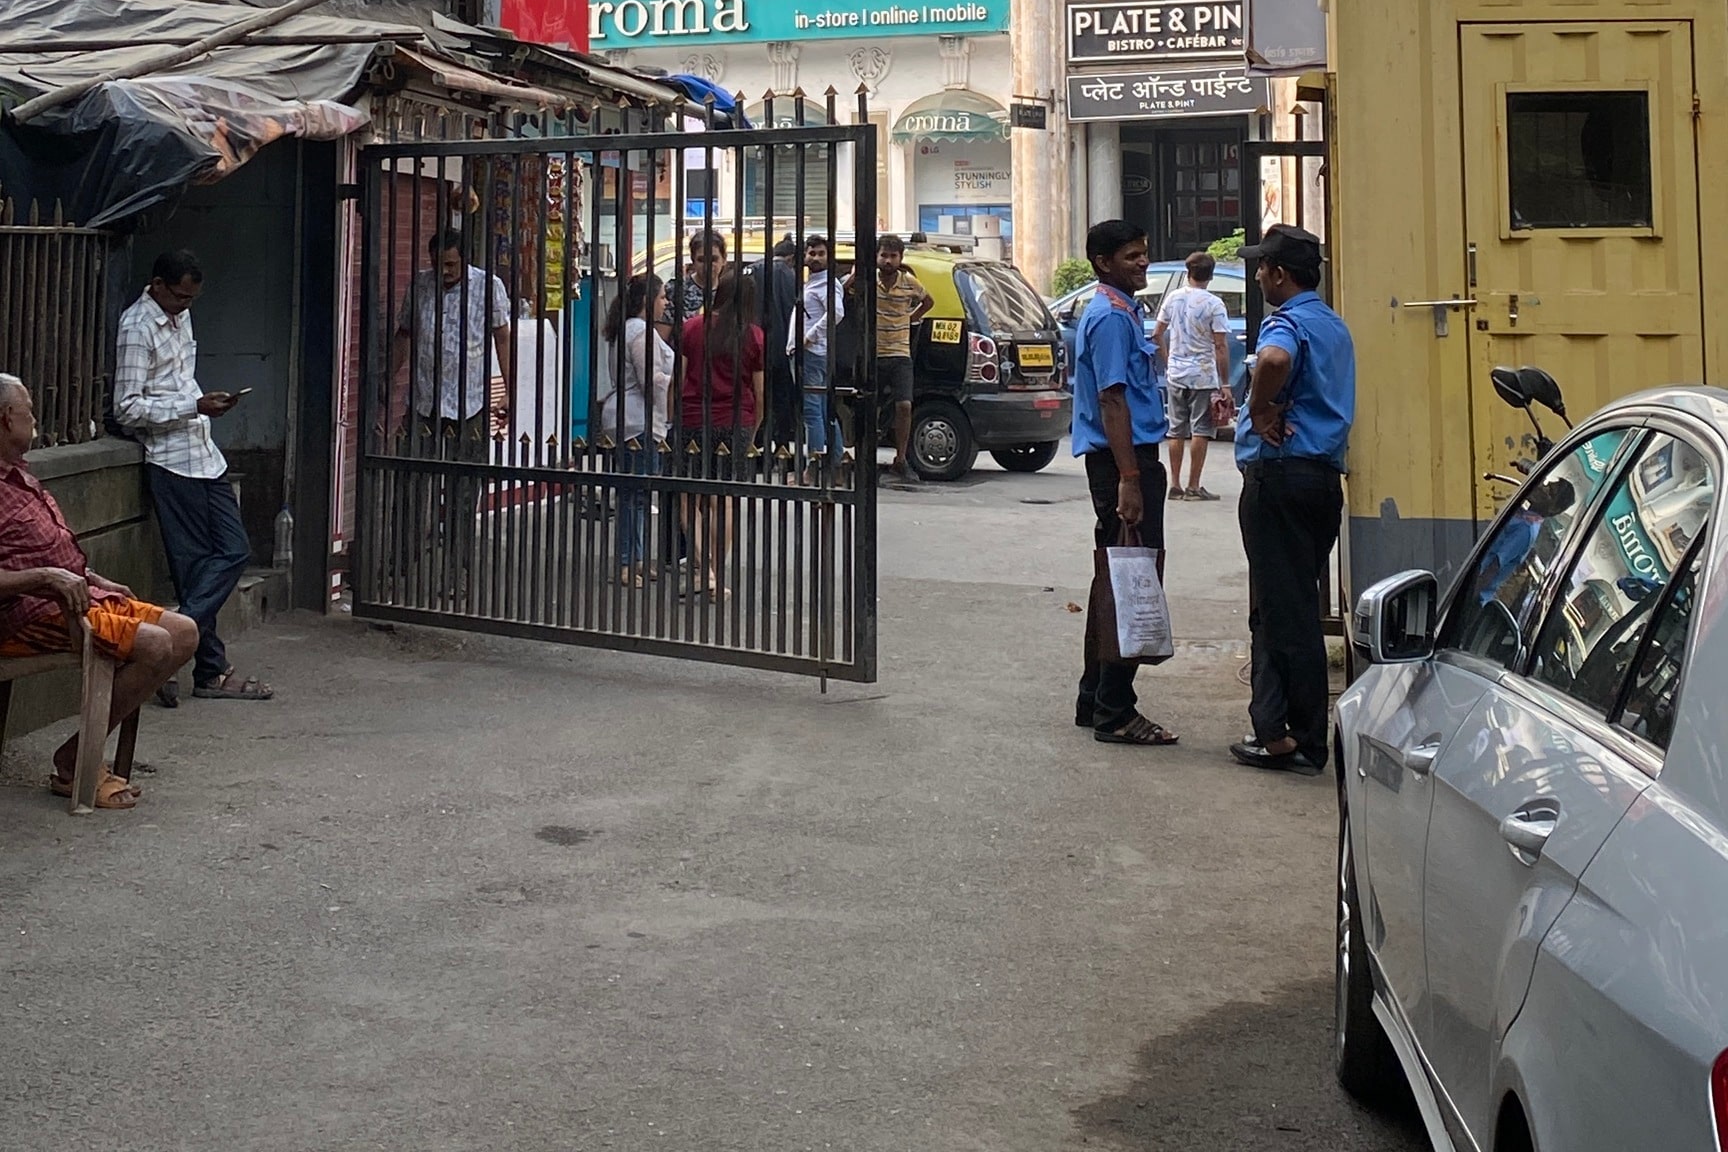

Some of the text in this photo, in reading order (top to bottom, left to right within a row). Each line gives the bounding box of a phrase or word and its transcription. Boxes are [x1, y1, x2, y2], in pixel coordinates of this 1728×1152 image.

[794, 9, 860, 29] in-store
[870, 5, 920, 25] online
[930, 2, 988, 23] mobile
[1075, 4, 1242, 36] PLATE & PIN
[1107, 38, 1155, 52] BISTRO
[1166, 33, 1227, 49] CAFÉBAR
[1081, 77, 1125, 101] प्लेट
[1132, 76, 1186, 99] ऑन्ड
[1139, 99, 1195, 110] PLATE & PINT
[905, 112, 970, 132] cromā
[954, 171, 1012, 181] STUNNINGLY
[954, 180, 992, 190] STYLISH
